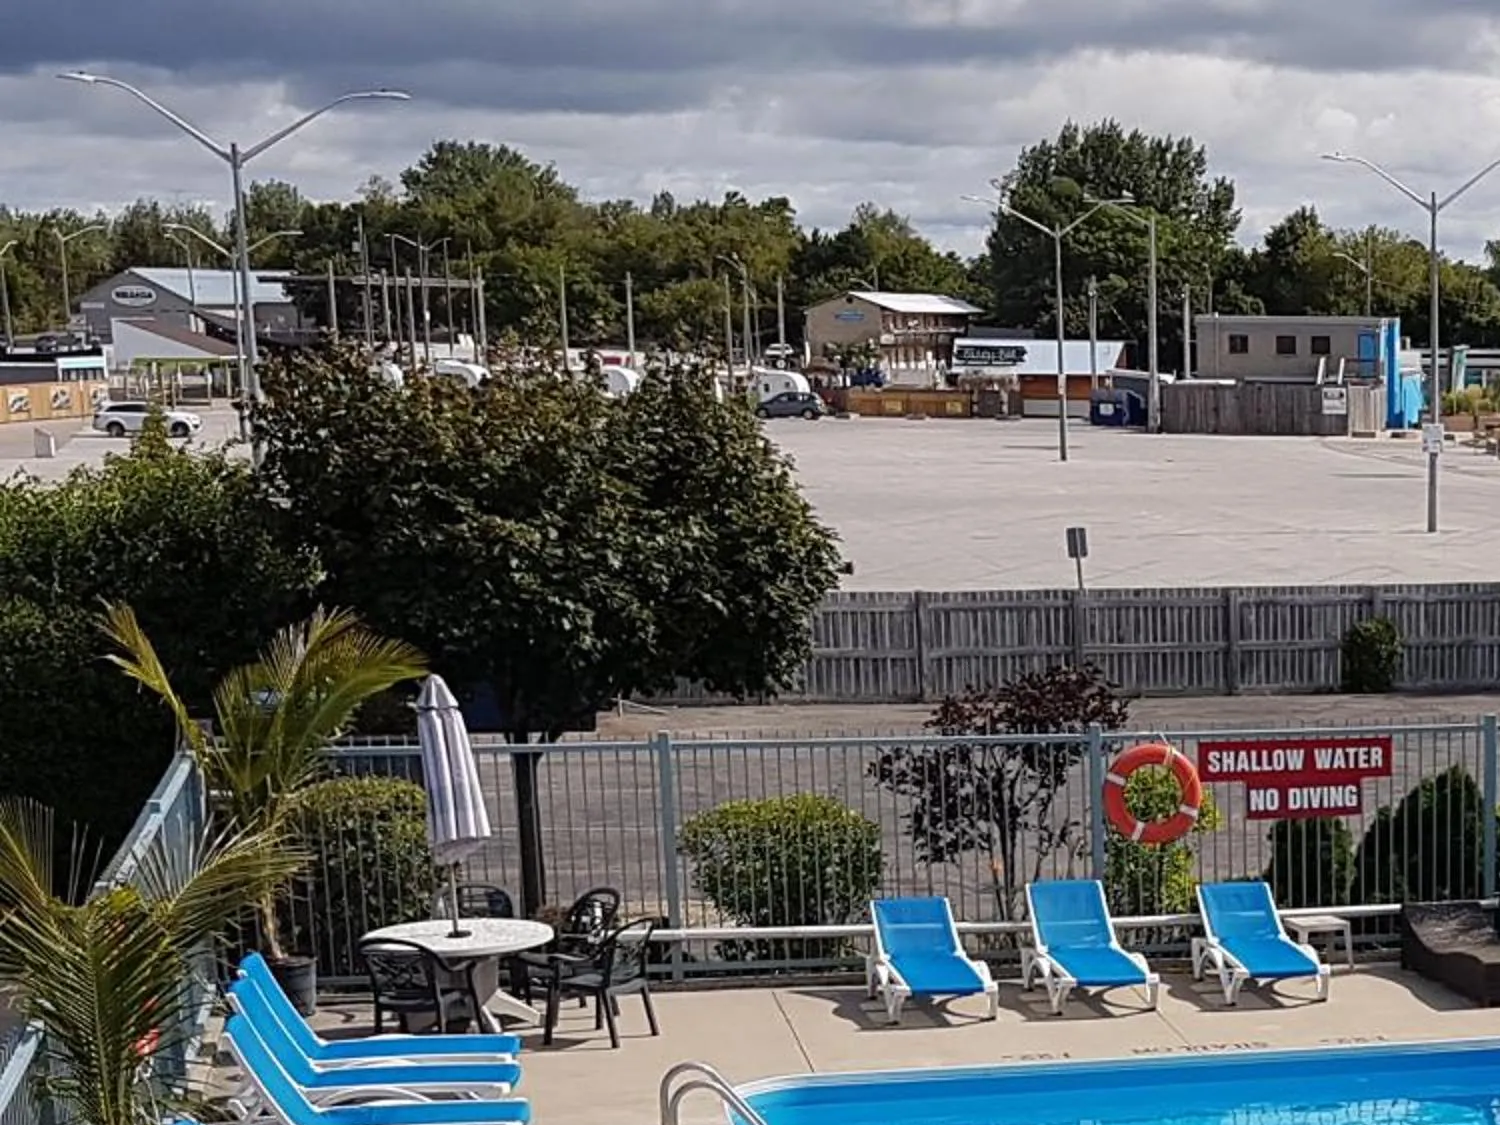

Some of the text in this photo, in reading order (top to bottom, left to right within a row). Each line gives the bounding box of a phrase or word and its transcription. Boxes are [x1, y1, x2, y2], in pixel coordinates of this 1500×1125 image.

[1207, 747, 1383, 773] SHALLOW WATER
[1249, 785, 1357, 811] NO DIVING
